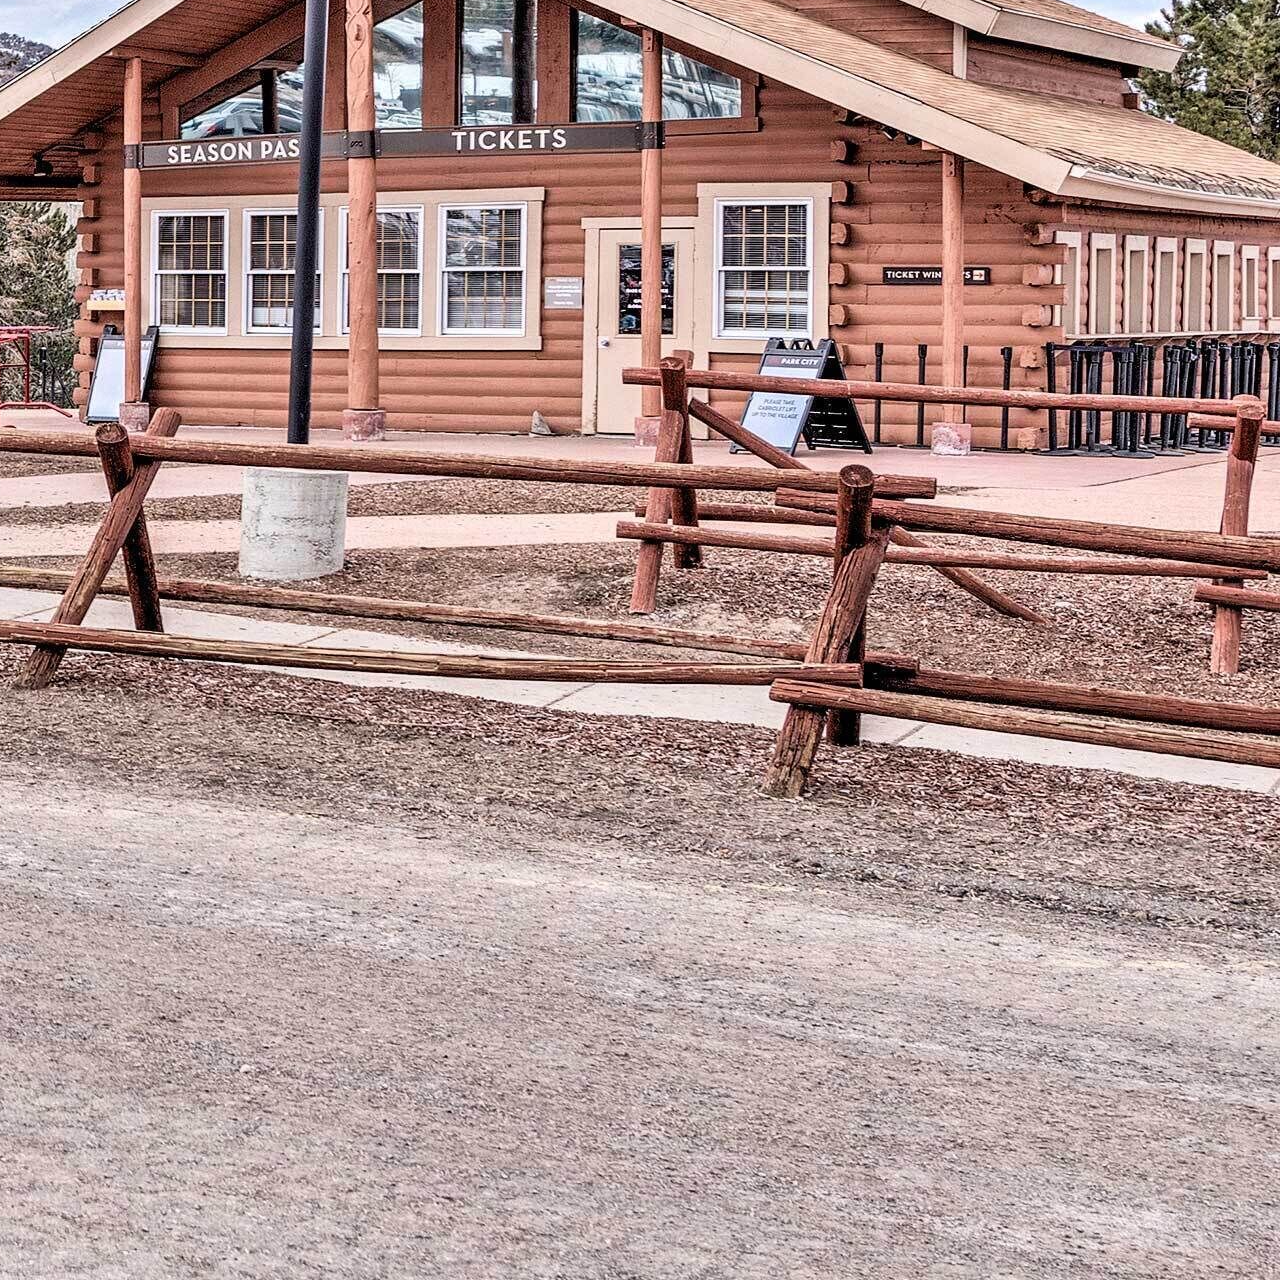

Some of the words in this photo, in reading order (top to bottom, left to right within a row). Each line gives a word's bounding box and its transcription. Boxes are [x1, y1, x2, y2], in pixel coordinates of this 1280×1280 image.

[452, 128, 567, 150] TICKETS
[167, 141, 252, 164] SEASON
[260, 139, 301, 159] PAS
[886, 271, 920, 279] TICKET
[922, 271, 971, 279] WINS
